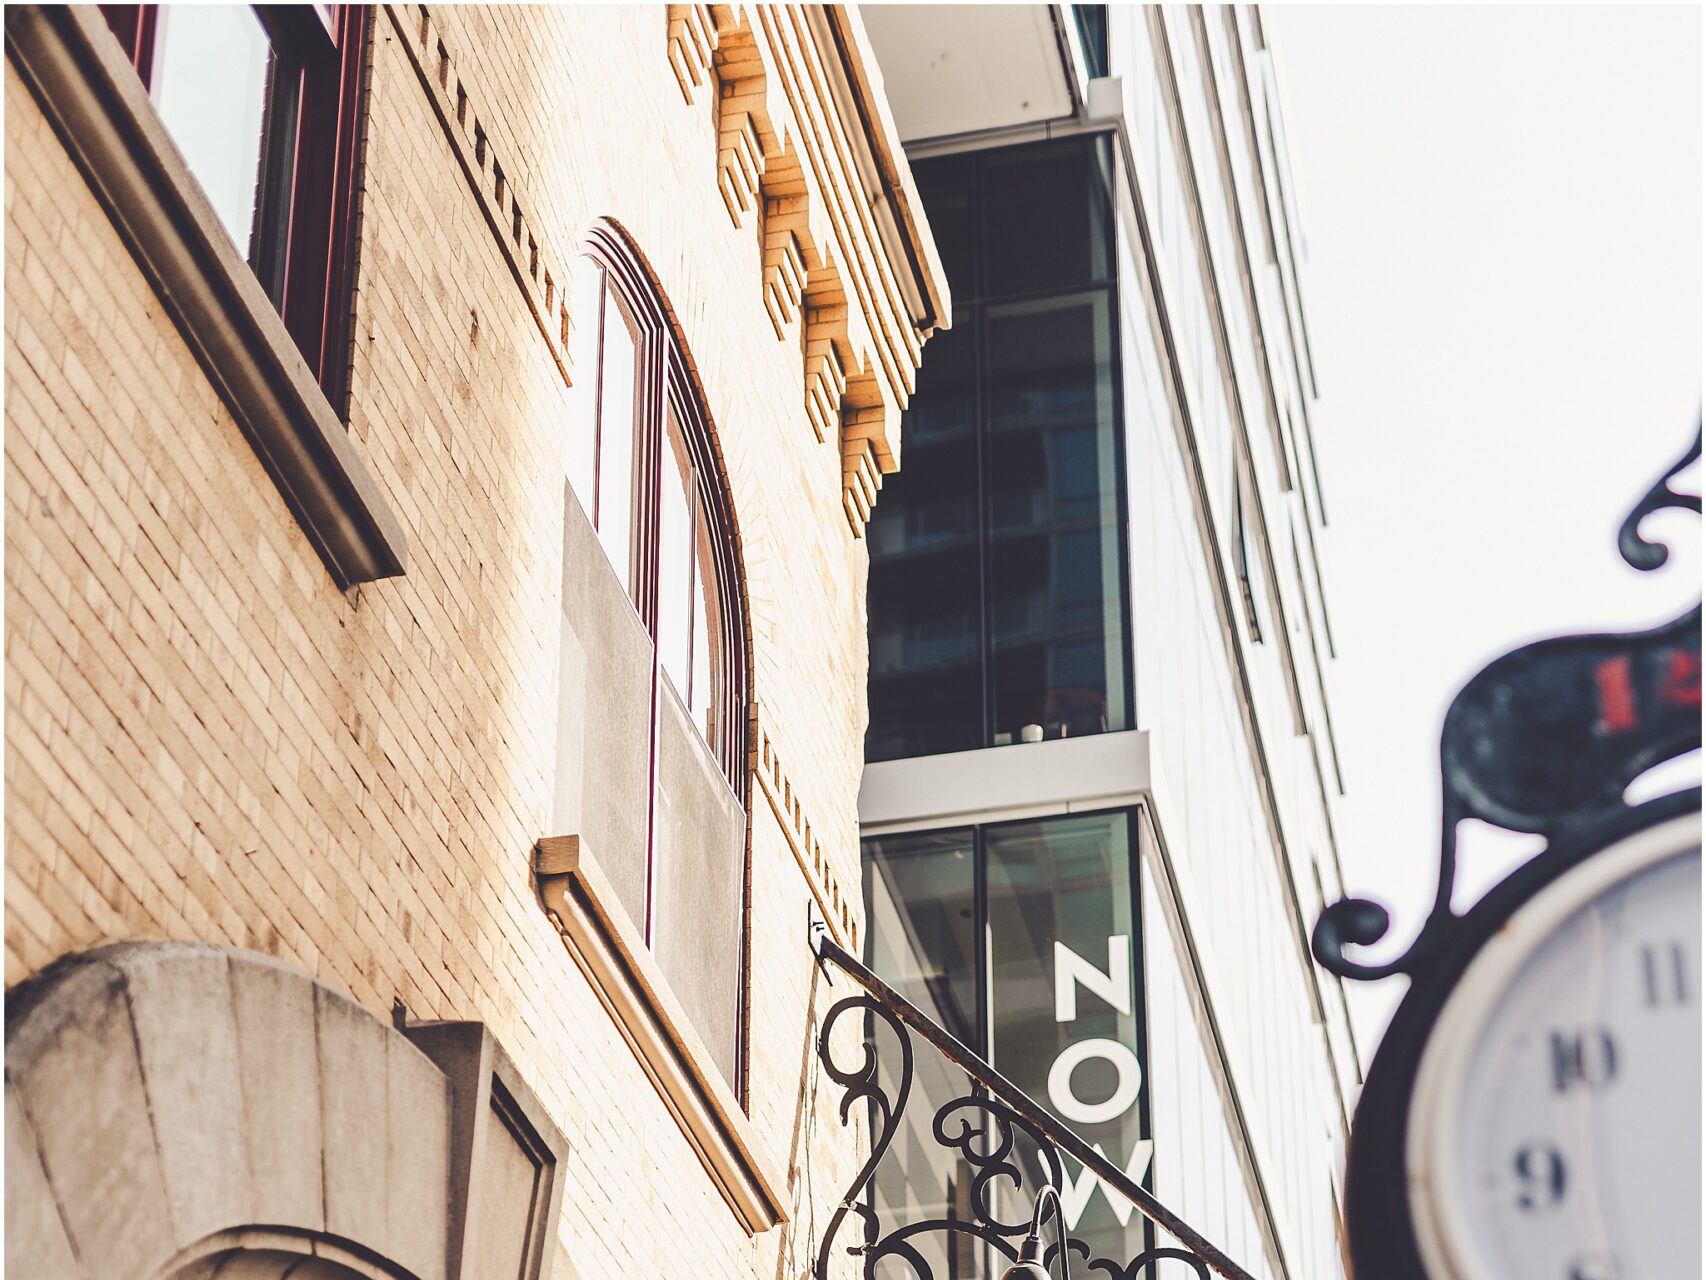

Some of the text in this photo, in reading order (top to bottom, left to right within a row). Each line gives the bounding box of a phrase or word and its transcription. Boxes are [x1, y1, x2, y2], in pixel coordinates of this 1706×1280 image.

[1642, 944, 1686, 1007] 11
[1037, 933, 1154, 1232] NOW
[1550, 1024, 1618, 1094] 10
[1513, 1142, 1567, 1213] 9
